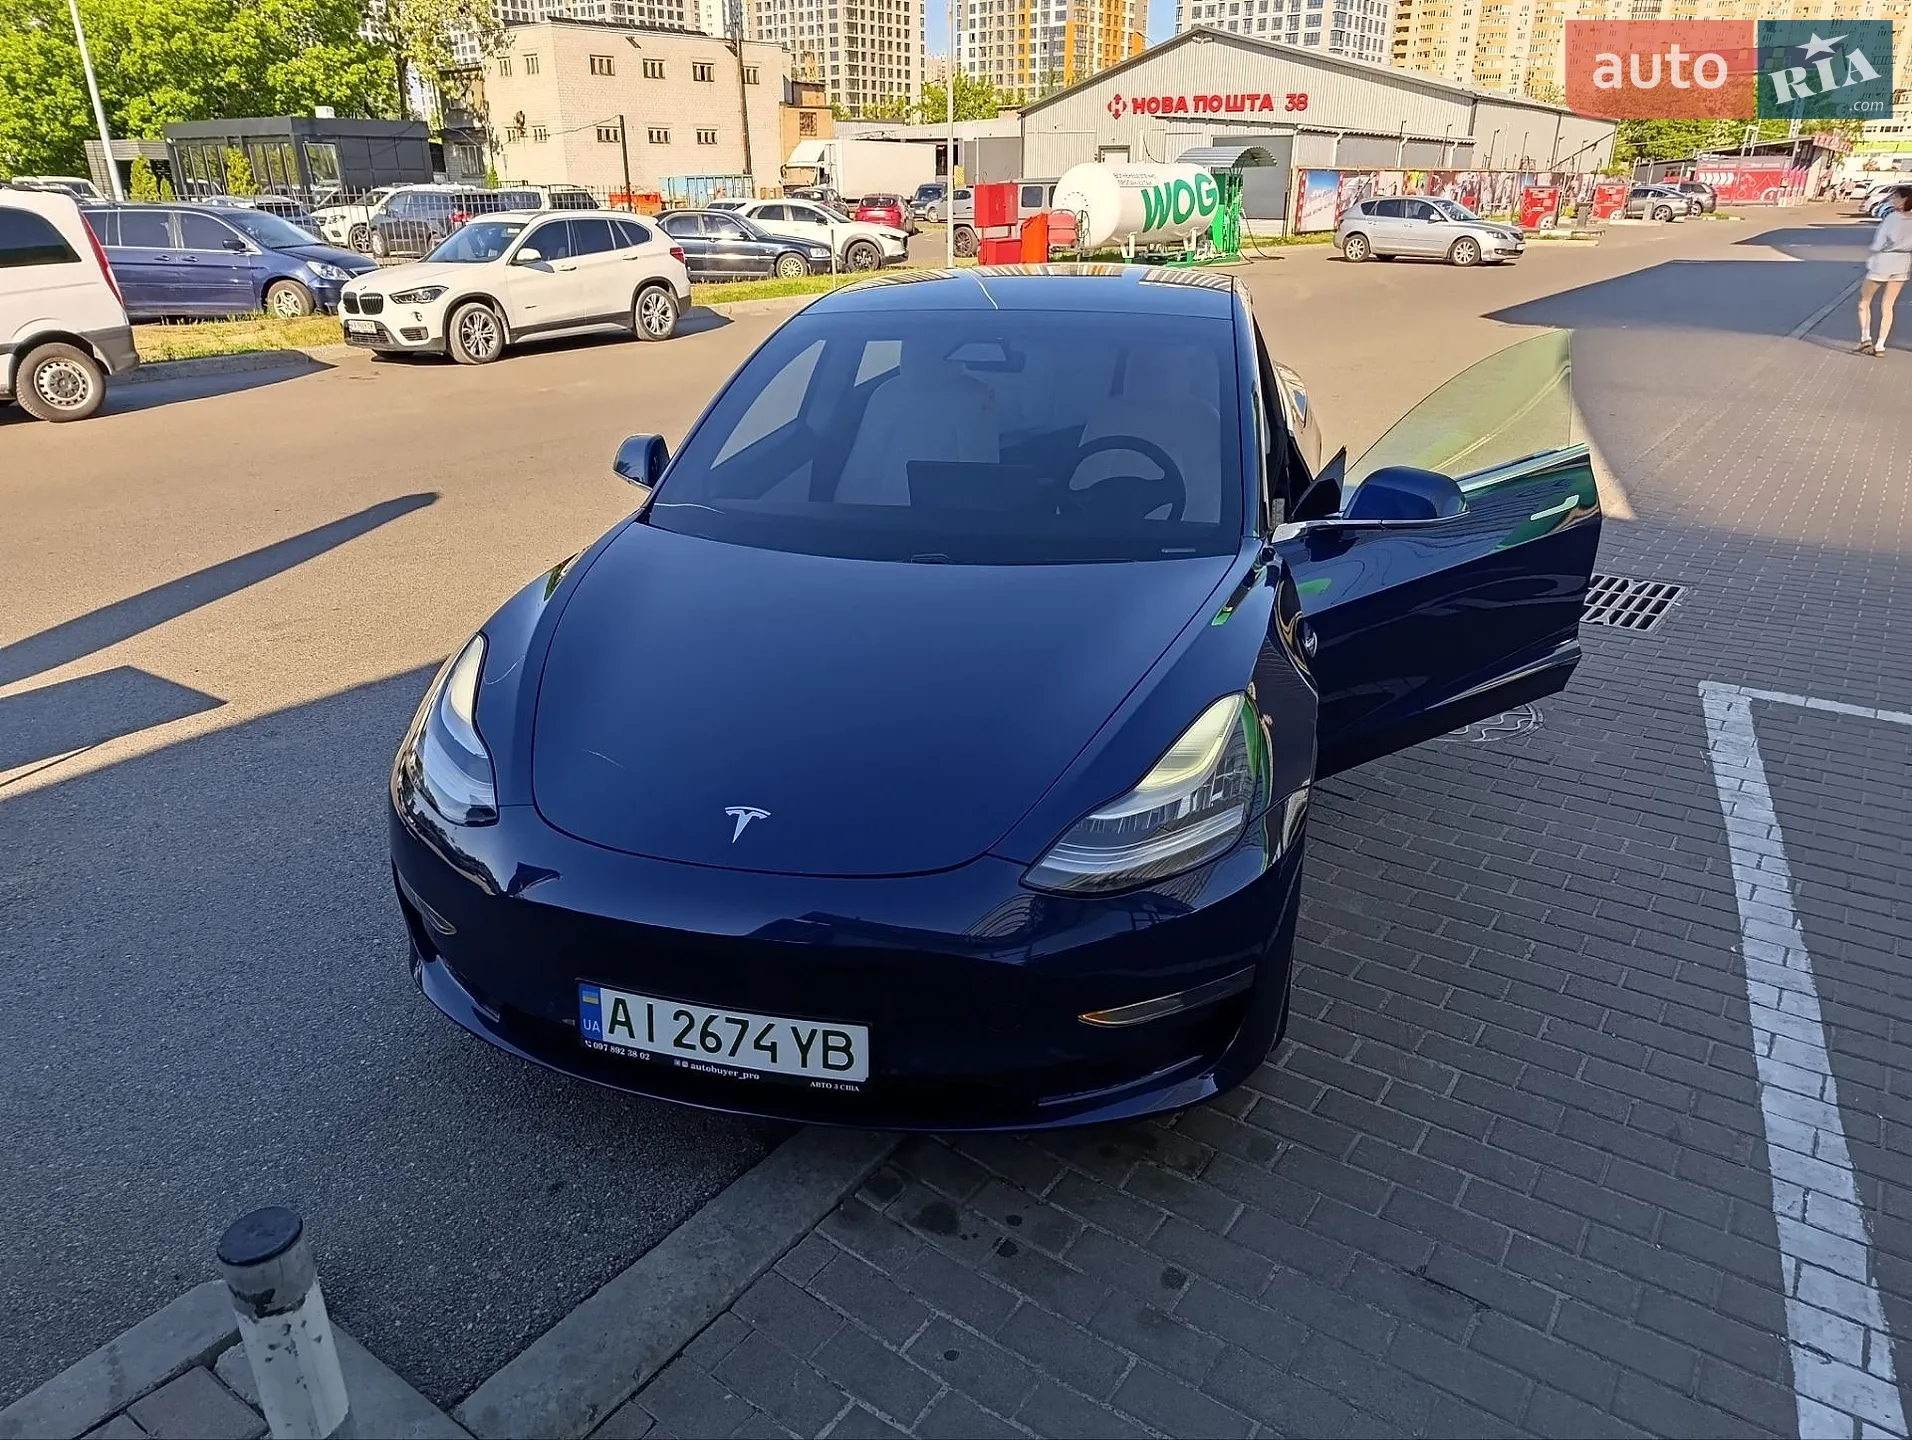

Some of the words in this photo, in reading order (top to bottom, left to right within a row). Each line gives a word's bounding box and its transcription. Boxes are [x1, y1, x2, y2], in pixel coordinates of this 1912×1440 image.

[1132, 96, 1188, 114] НОВА
[1193, 94, 1273, 113] ПОШТА
[1285, 93, 1309, 112] 38
[1140, 173, 1219, 233] WOG
[583, 1018, 600, 1034] UA
[673, 1009, 778, 1063] 2674
[593, 1042, 609, 1052] 097
[639, 1052, 651, 1061] 02
[690, 1062, 760, 1080] autobuyer_pro
[810, 1081, 833, 1089] АВТО
[840, 1084, 860, 1092] США
